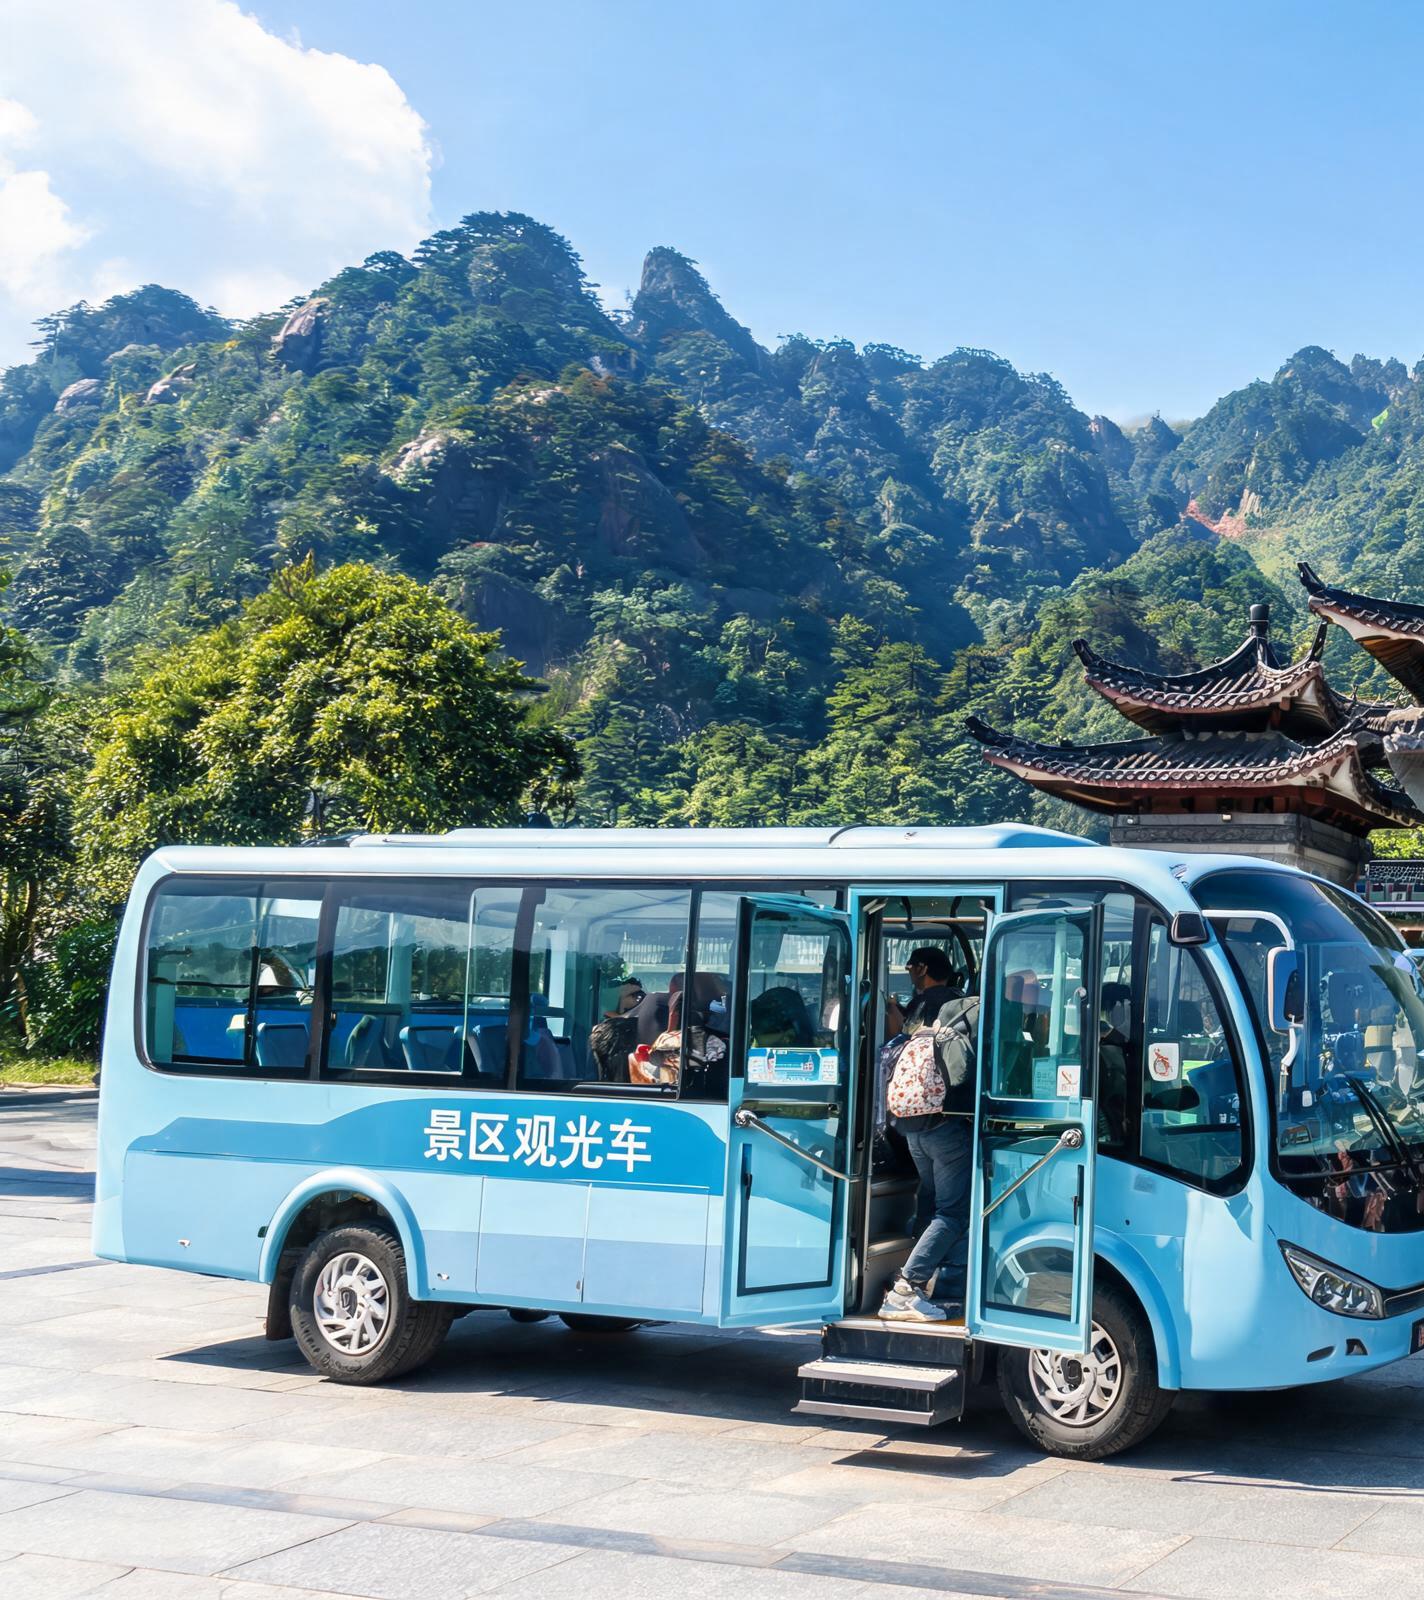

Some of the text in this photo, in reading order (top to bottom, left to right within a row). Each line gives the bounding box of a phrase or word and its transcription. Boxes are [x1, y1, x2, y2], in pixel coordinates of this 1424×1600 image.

[423, 1109, 652, 1173] 景区观光车
